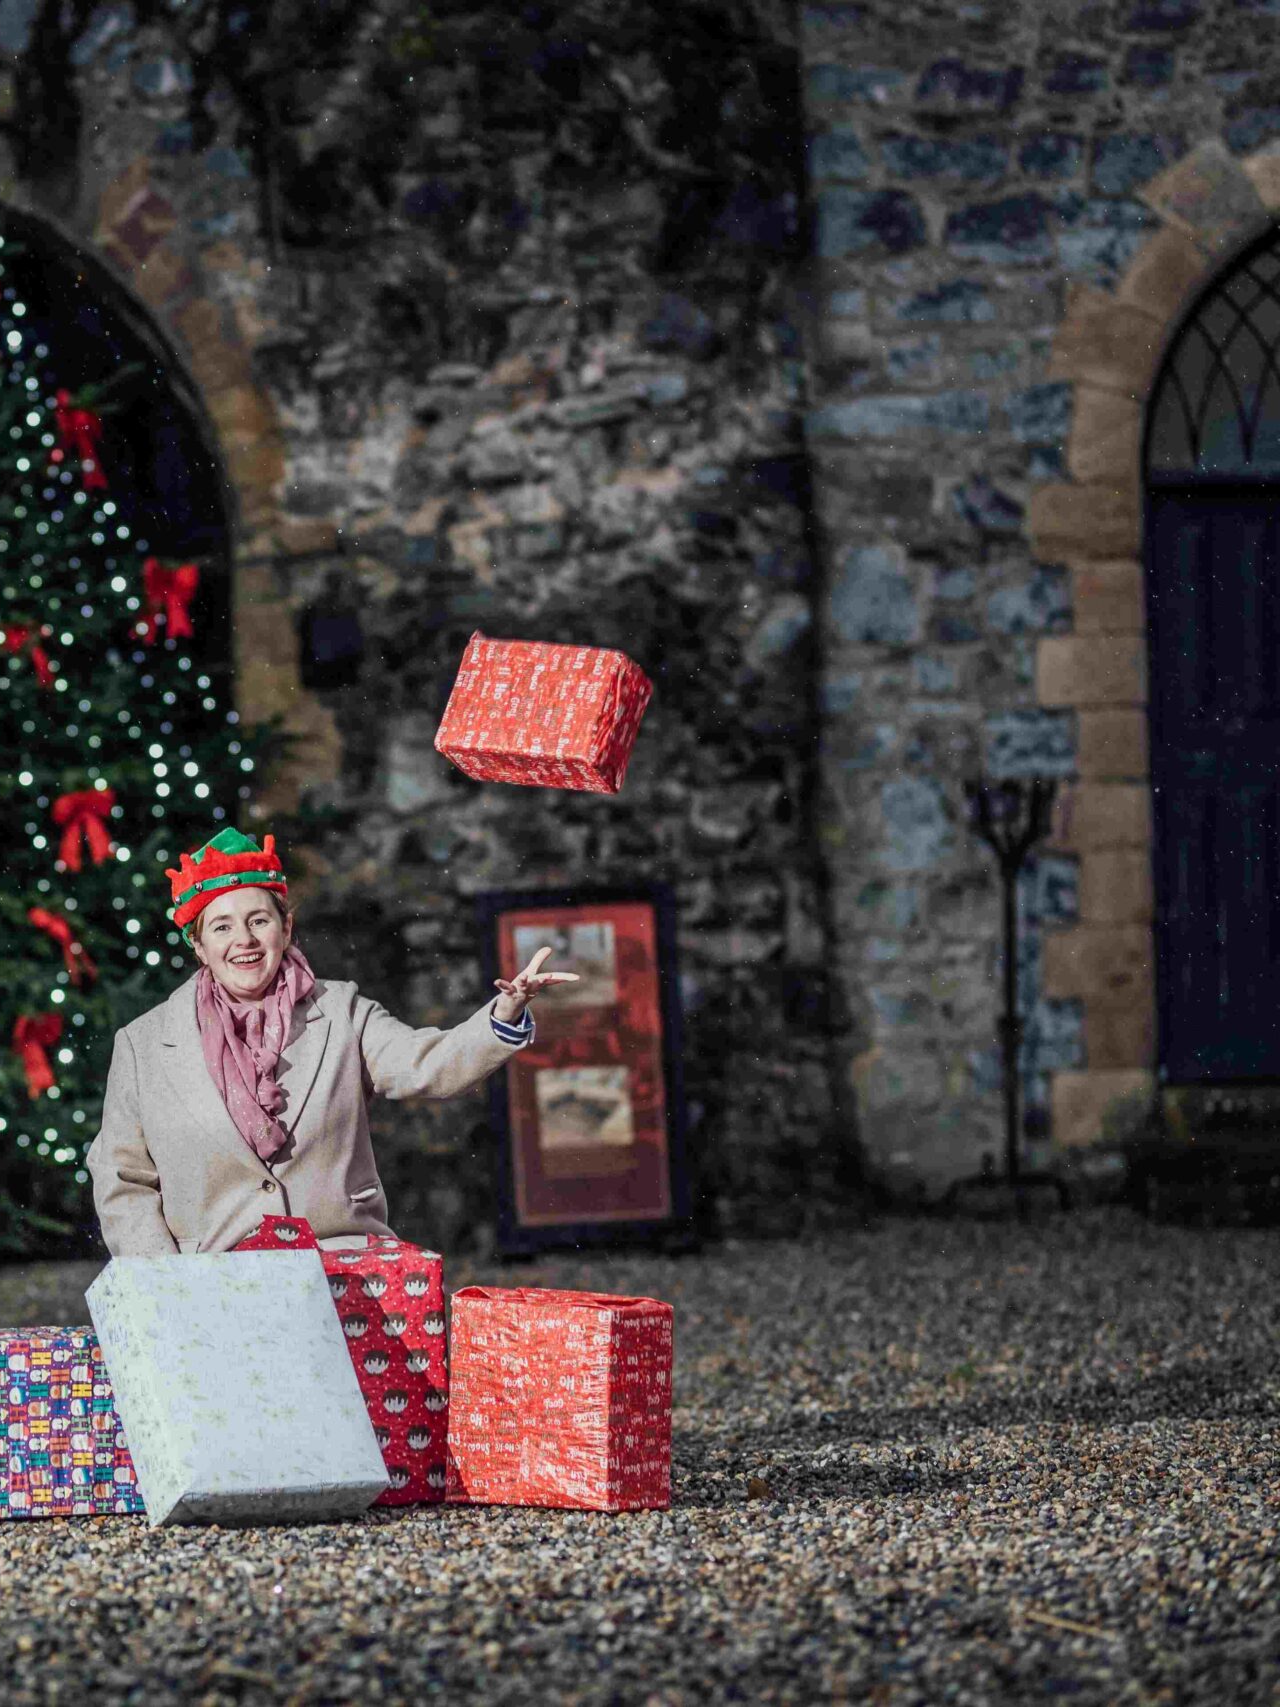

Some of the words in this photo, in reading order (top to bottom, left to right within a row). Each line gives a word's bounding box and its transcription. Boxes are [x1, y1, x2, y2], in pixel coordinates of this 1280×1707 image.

[9, 1341, 29, 1352] H
[32, 1352, 51, 1364] H
[72, 1350, 90, 1363] H
[11, 1373, 27, 1385] H
[51, 1369, 69, 1382] H
[29, 1385, 48, 1396] H
[72, 1384, 92, 1397] H
[52, 1401, 69, 1414] H
[92, 1400, 113, 1411] H
[9, 1406, 27, 1421] H
[30, 1421, 49, 1433] H
[71, 1417, 91, 1432] H
[50, 1438, 69, 1450] H
[96, 1434, 113, 1447] H
[10, 1442, 25, 1454] H
[30, 1453, 49, 1465] H
[73, 1453, 93, 1465] H
[53, 1470, 69, 1483] H
[95, 1468, 113, 1480] H
[10, 1475, 27, 1489] H
[33, 1489, 52, 1502] H
[74, 1485, 92, 1499] H
[117, 1486, 132, 1498] H
